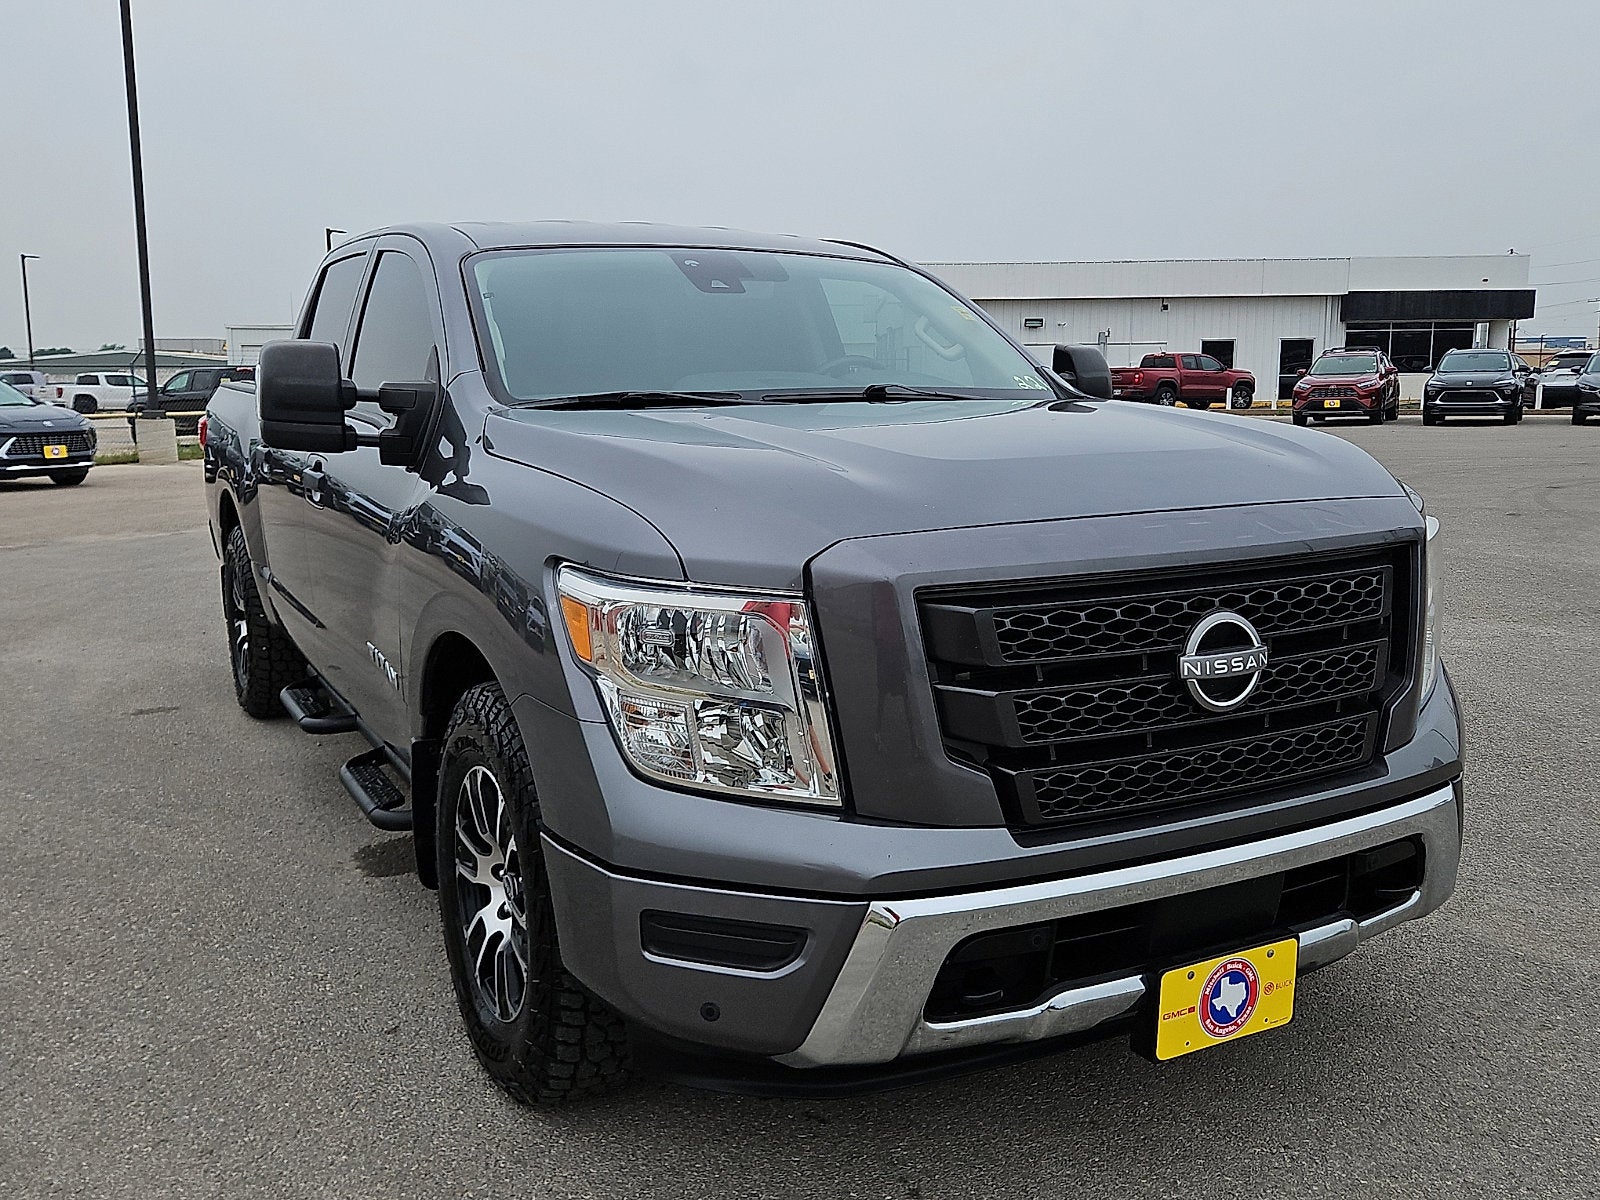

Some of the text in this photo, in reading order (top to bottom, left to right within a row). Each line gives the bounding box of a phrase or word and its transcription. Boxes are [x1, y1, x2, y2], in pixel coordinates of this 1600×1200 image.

[1183, 652, 1267, 676] NISSAN
[1226, 962, 1243, 970] Buick
[1245, 967, 1255, 982] GMC
[1275, 979, 1293, 990] BUICK
[1163, 1008, 1187, 1020] GMC
[1205, 1018, 1214, 1031] San
[1236, 1006, 1252, 1025] Texas
